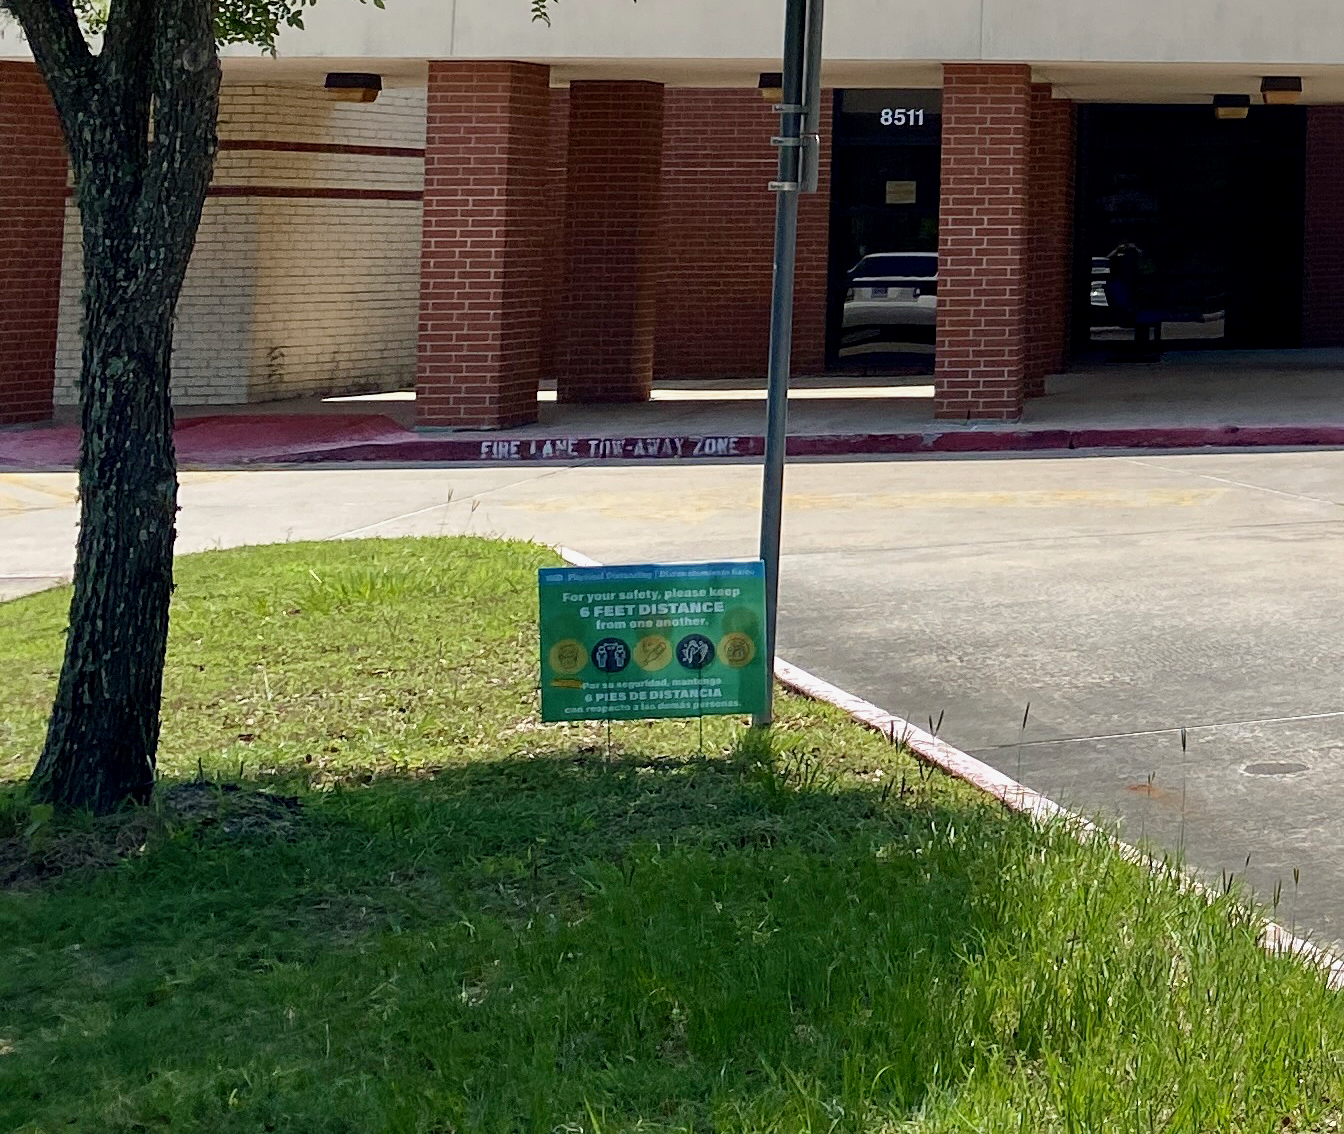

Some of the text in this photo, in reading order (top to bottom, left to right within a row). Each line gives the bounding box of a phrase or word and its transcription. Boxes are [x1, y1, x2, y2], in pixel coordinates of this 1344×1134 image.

[880, 108, 924, 126] 8511
[480, 436, 739, 460] FIRE LANE TOW-AWAY ZONE
[562, 587, 740, 604] For your safety, please keep
[580, 602, 724, 618] 6 FEET DISTANCE
[596, 618, 710, 630] from one another.
[584, 688, 722, 702] 6 PIES DE DISTANCIA
